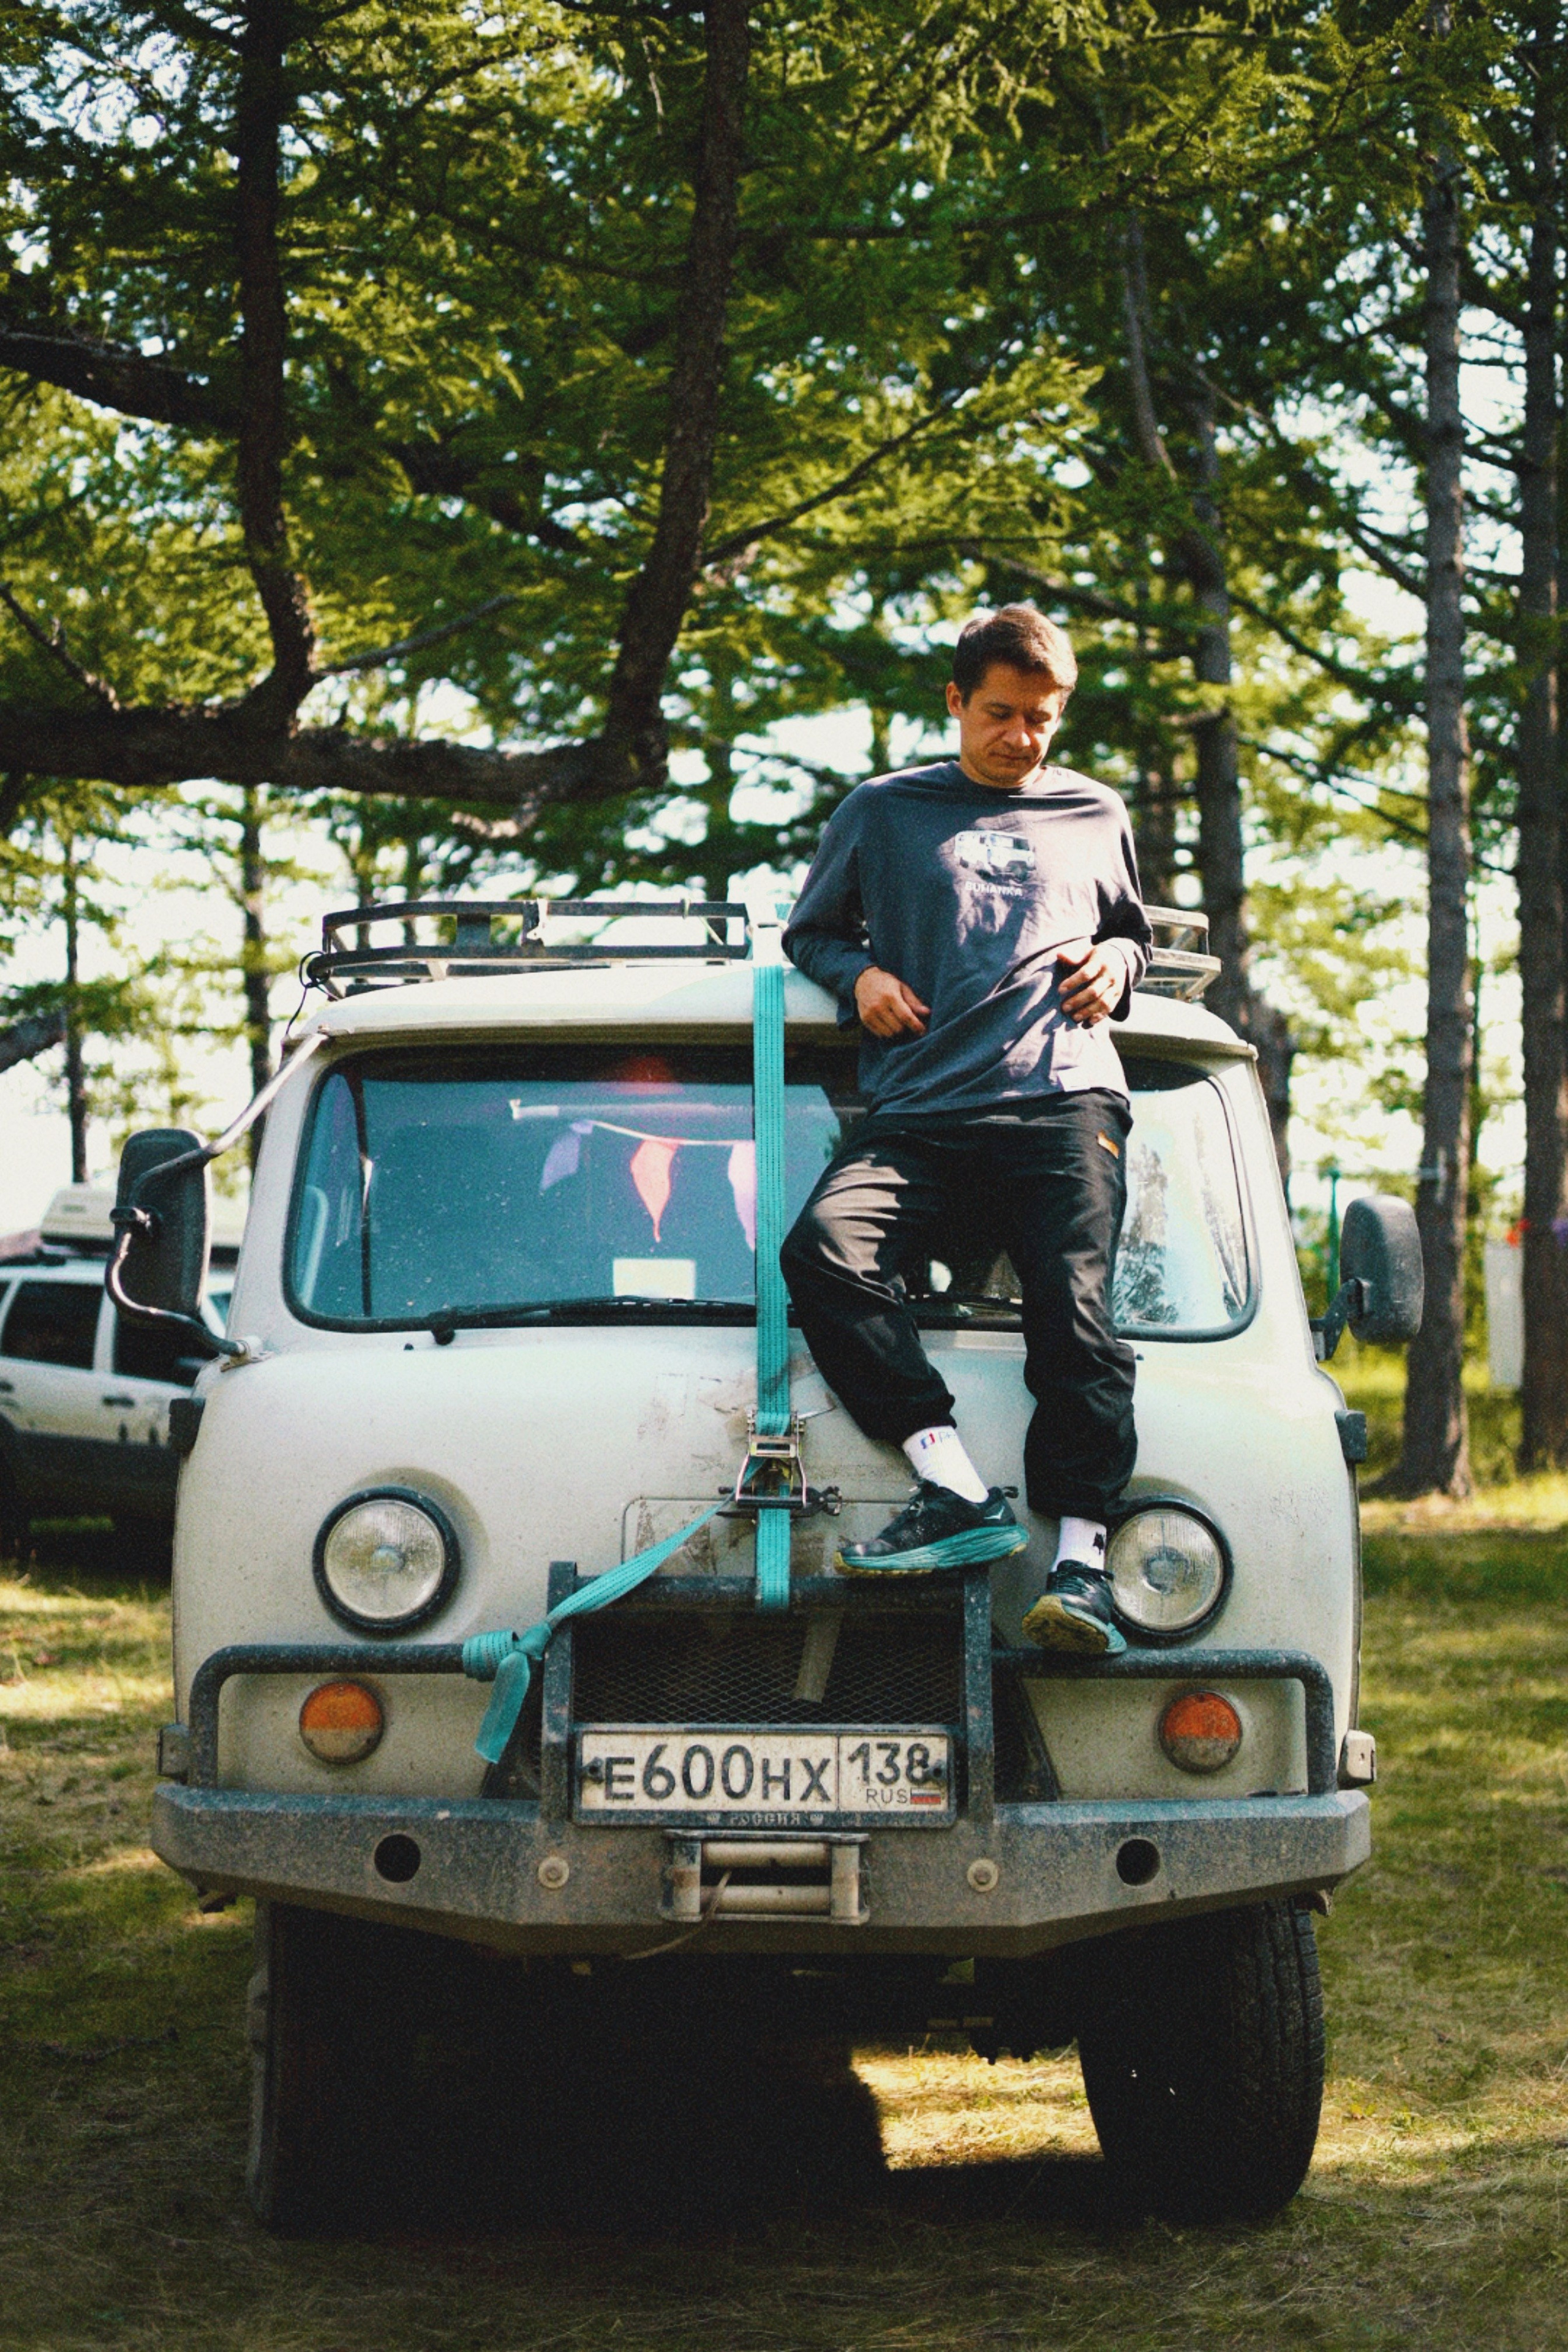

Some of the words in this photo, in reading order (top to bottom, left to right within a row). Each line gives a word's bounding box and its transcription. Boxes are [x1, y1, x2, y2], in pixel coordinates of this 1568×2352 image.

[965, 881, 1023, 896] BUHANKA
[605, 1744, 831, 1801] E600HX
[848, 1742, 929, 1785] 138
[866, 1789, 908, 1803] RUS
